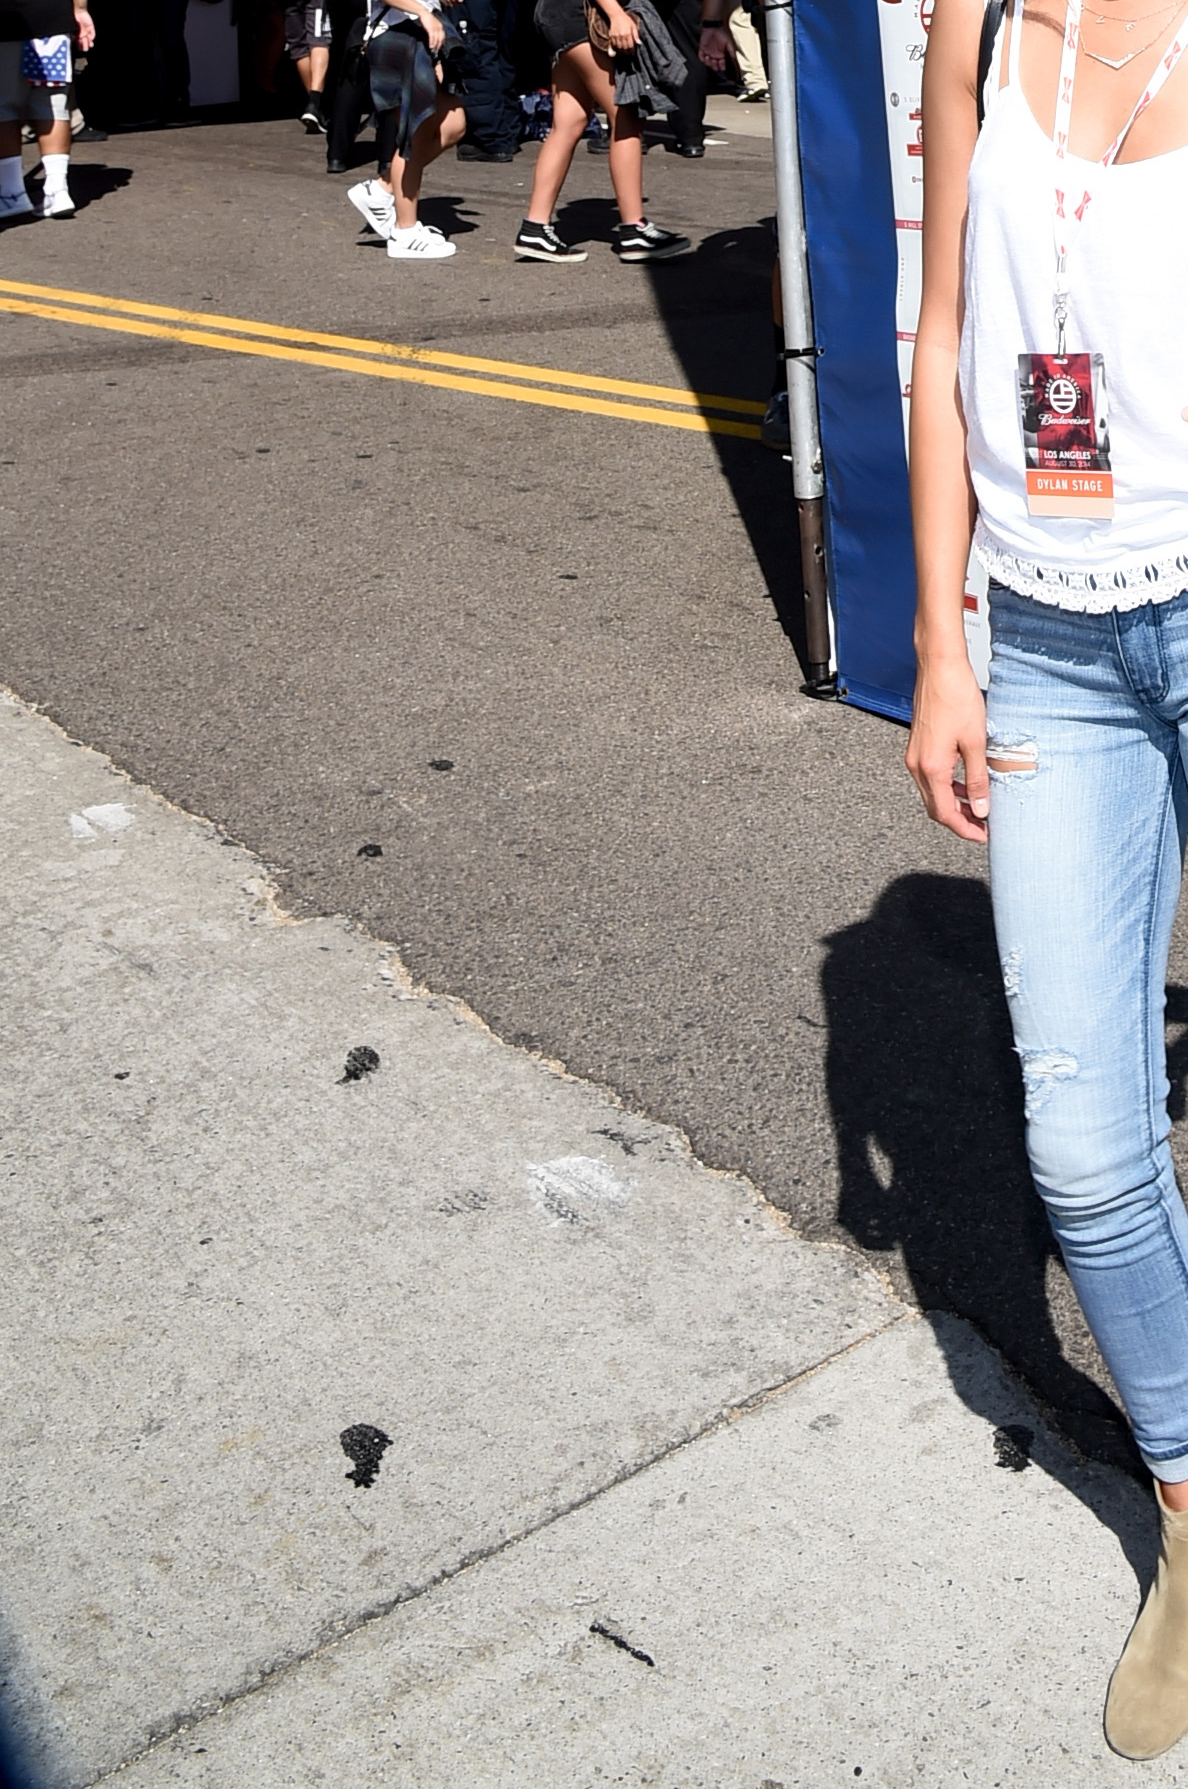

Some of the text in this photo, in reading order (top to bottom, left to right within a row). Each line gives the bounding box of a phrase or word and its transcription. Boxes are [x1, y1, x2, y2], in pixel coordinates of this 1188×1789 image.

[1037, 413, 1092, 426] Budweiser
[1043, 450, 1092, 461] LOS ANGELES
[1044, 460, 1068, 468] AUGUST
[1036, 477, 1104, 493] DYLAN STAGE
